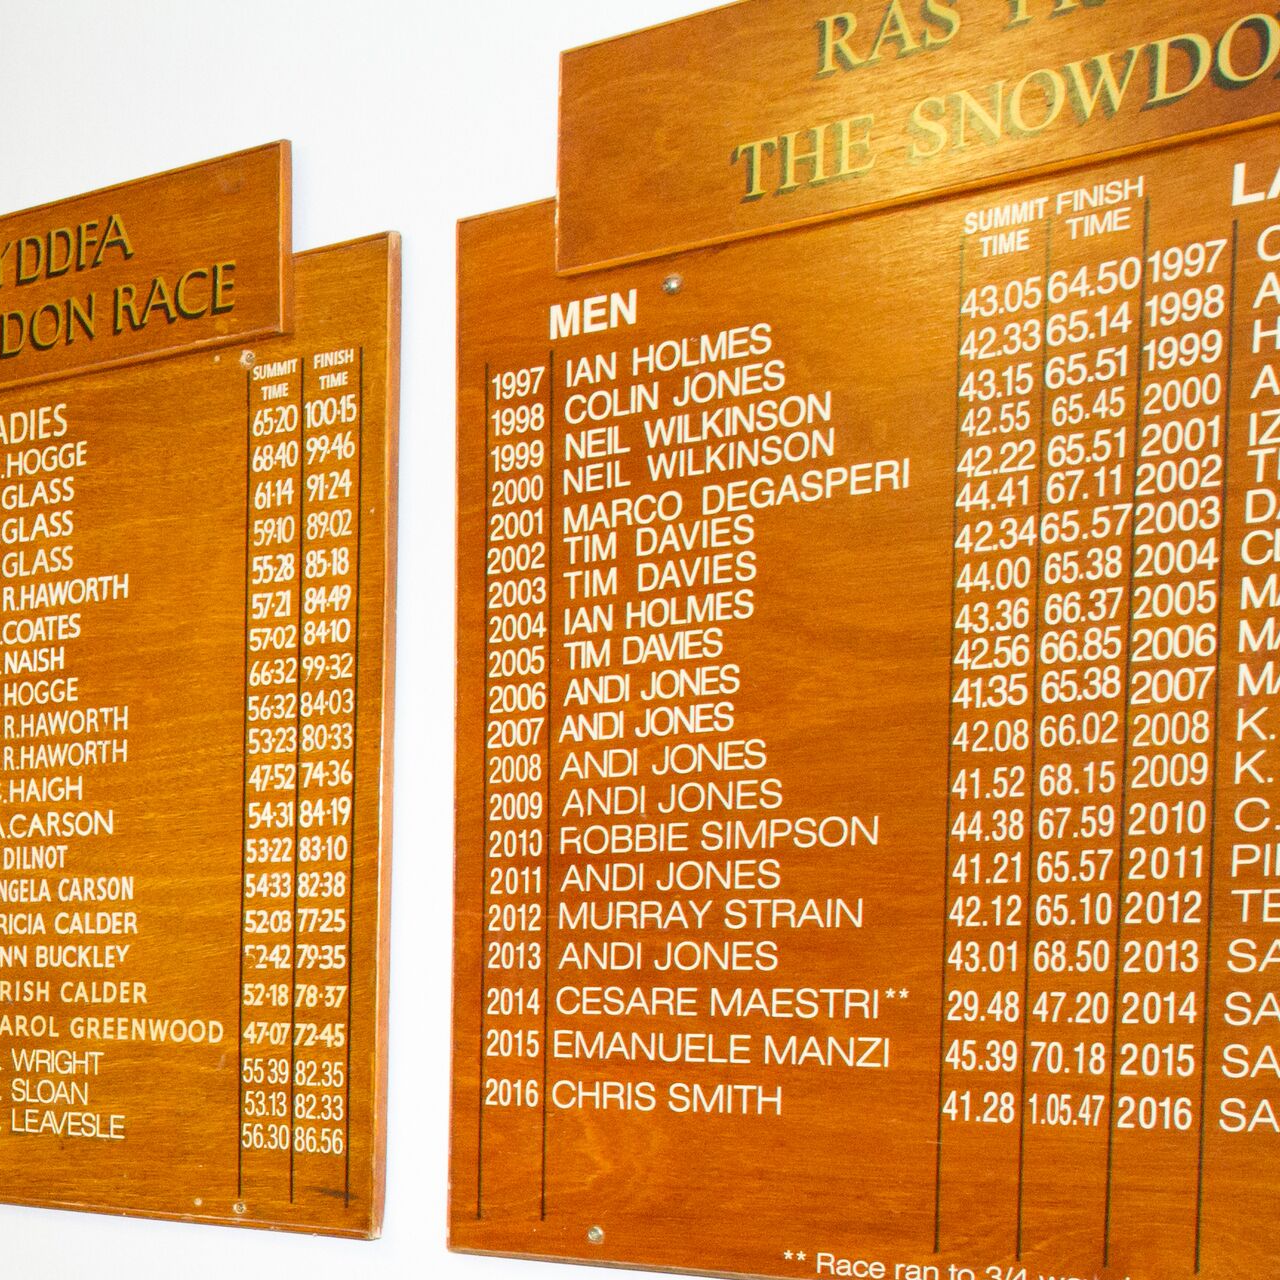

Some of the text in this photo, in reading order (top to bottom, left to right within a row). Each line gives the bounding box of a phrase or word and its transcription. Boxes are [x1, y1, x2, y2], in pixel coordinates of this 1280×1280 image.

[816, 0, 962, 77] RAS
[732, 114, 877, 204] THE
[963, 175, 1144, 236] SUMMIT FINISH
[978, 206, 1132, 259] TIME TIME
[112, 259, 237, 336] RACE
[549, 288, 638, 341] MEN
[491, 239, 1227, 401] 1997 IAN HOLMES 43.05 64.50 1997
[253, 348, 354, 381] SUMMIT FINISH
[260, 370, 349, 401] TIME TIME
[563, 358, 786, 425] COLIN JONES
[564, 390, 832, 462] NEIL WILKINSON
[562, 426, 835, 496] NEIL WILKINSON
[562, 457, 910, 535] MARCO DEGASPERI
[562, 513, 755, 565] TIM DAVIES
[562, 549, 758, 600] TIM DAVIES
[563, 588, 755, 636] IAN HOLMES
[563, 627, 724, 671] TIM DAVIES
[562, 663, 741, 707] ANDI JONES
[558, 700, 735, 744] ANDI JONES
[559, 738, 768, 781] ANDI JONES
[561, 777, 783, 818] ANDI JONES
[700, 815, 879, 852] SIMPSON
[57, 875, 135, 902] CARSON
[559, 858, 782, 893] ANDI JONES
[53, 911, 139, 935] CALDER
[558, 897, 864, 931] MURRAY STRAIN
[35, 944, 131, 969] BUCKLEY
[557, 940, 779, 972] ANDI JONES
[59, 981, 148, 1004] CALDER
[486, 987, 541, 1016] 2014
[555, 985, 699, 1017] CESARE
[947, 990, 1020, 1023] 29.48
[1032, 991, 1110, 1025] 47.20
[1121, 991, 1198, 1025] 2014
[69, 1016, 224, 1044] GREENWOOD
[10, 1047, 105, 1076] WRIGHT
[485, 1028, 1196, 1077] 2015 EMANUELE MANZI 45.39 70.18 2015
[11, 1077, 89, 1106] SLOAN
[483, 1077, 1193, 1131] 2016 CHRIS SMITH 41.28 1.05.47 2016
[11, 1107, 126, 1140] LEAVESLE
[815, 1252, 886, 1279] Race
